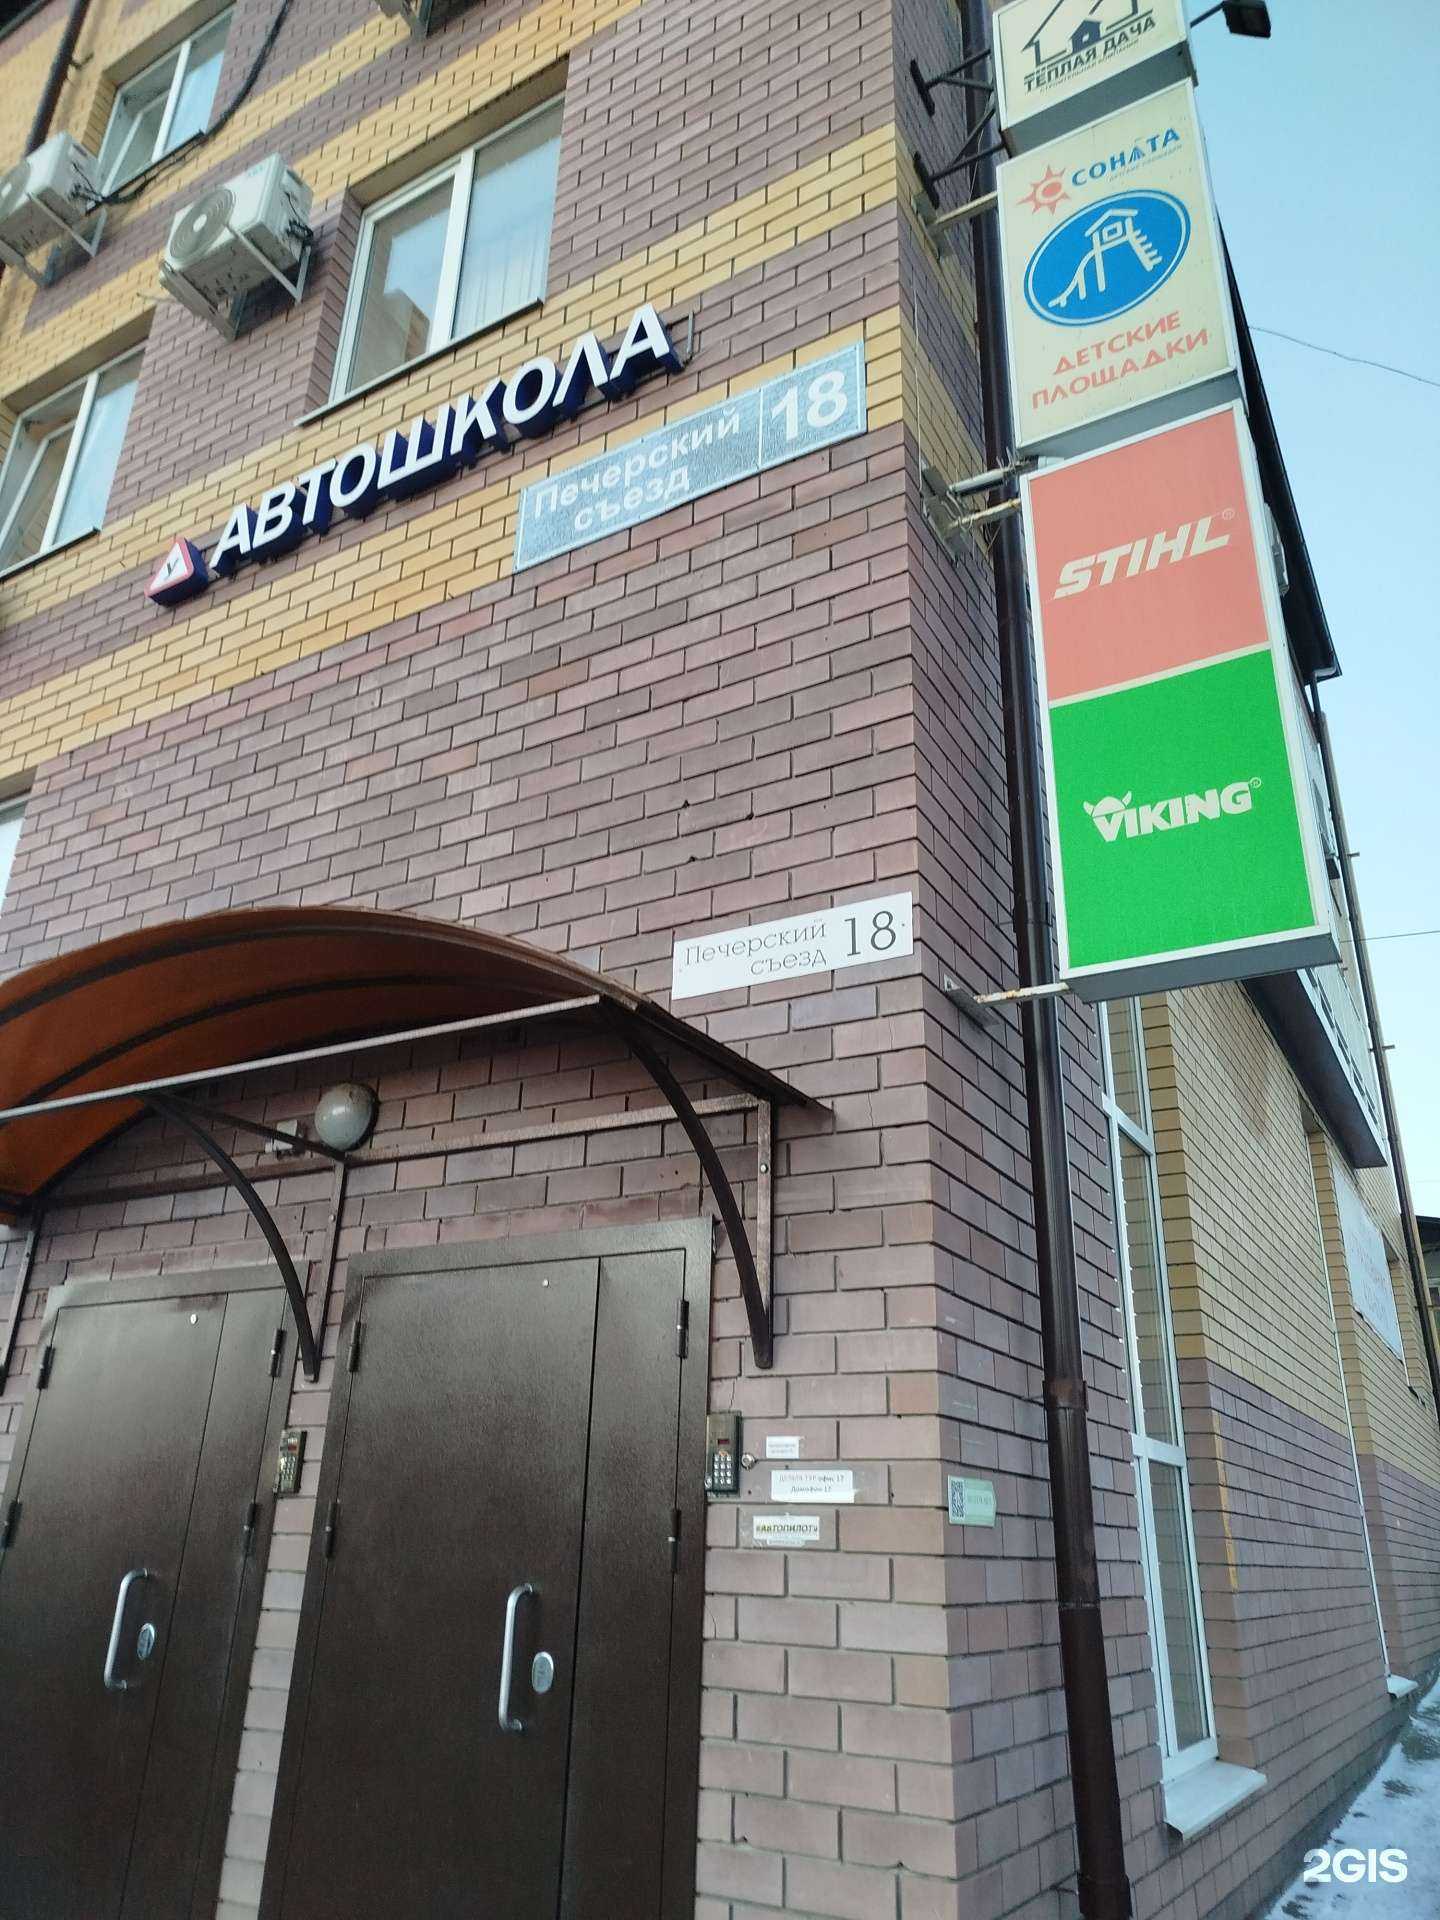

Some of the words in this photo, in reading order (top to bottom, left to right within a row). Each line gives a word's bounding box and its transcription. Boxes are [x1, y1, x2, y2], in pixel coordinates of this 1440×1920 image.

[1023, 47, 1097, 93] ТЕПЛАЯ
[1103, 16, 1156, 57] ДАЧА
[1071, 127, 1181, 187] СОНАТА
[1032, 329, 1209, 410] ПЛОЩАДКИ
[1053, 311, 1181, 376] ДЕТСКИЕ
[208, 303, 671, 570] АВТОШКОЛА
[534, 407, 740, 519] Печерский
[770, 370, 849, 441] 18
[573, 465, 690, 532] съезд
[1053, 515, 1233, 600] STIHL
[684, 918, 828, 967] Печерский
[844, 910, 897, 957] 18
[749, 948, 828, 976] съезд
